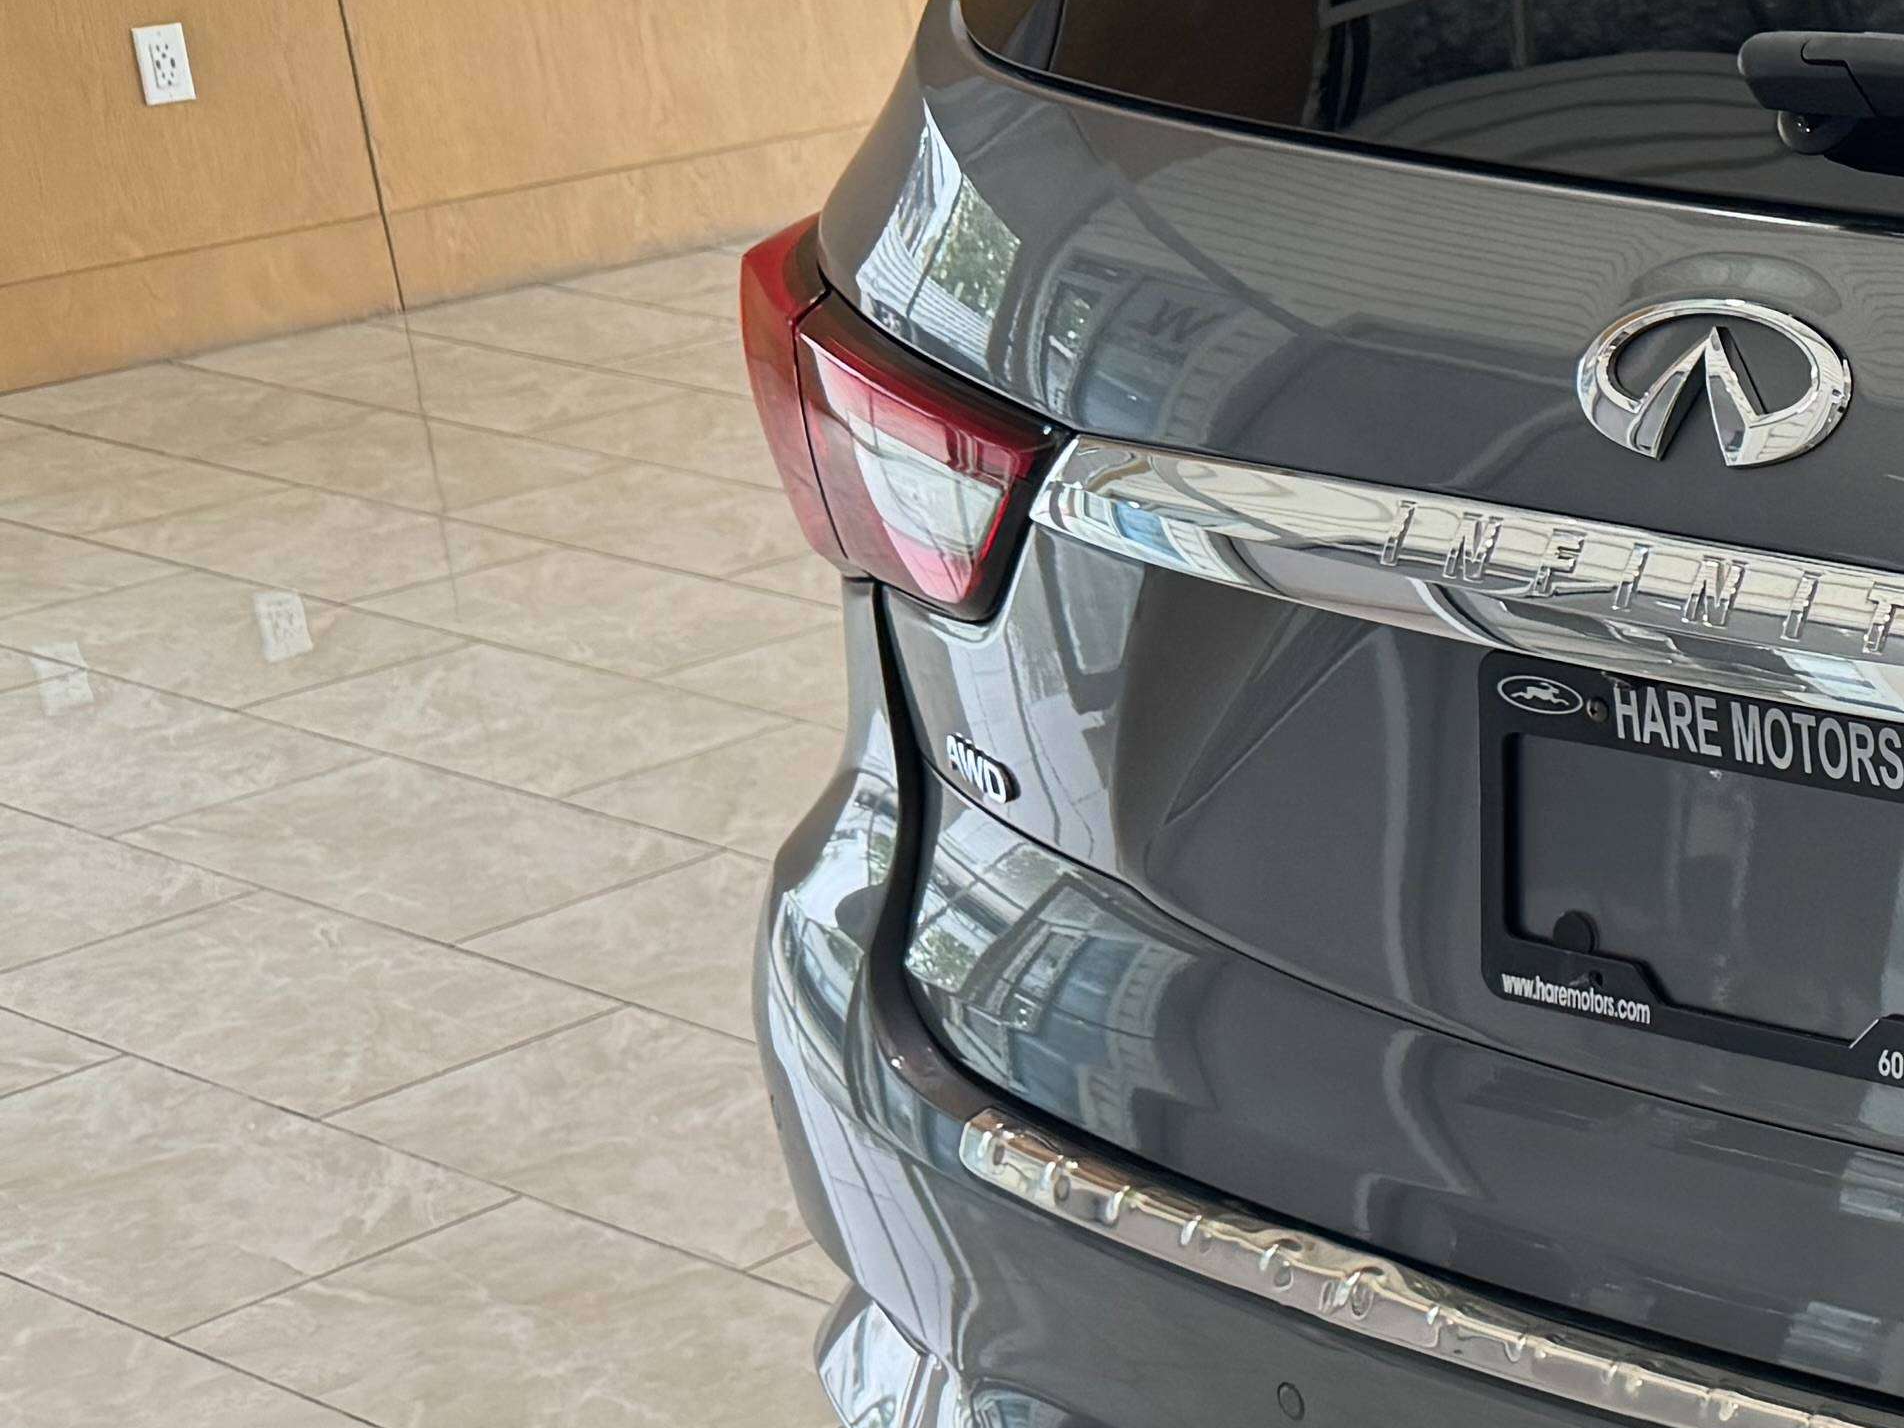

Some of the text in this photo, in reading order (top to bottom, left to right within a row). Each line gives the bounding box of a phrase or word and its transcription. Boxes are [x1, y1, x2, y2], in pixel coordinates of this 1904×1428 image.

[946, 733, 1007, 804] AWD
[1613, 686, 1904, 790] HARE MOTORS
[1501, 973, 1651, 1025] www.haremotors.com
